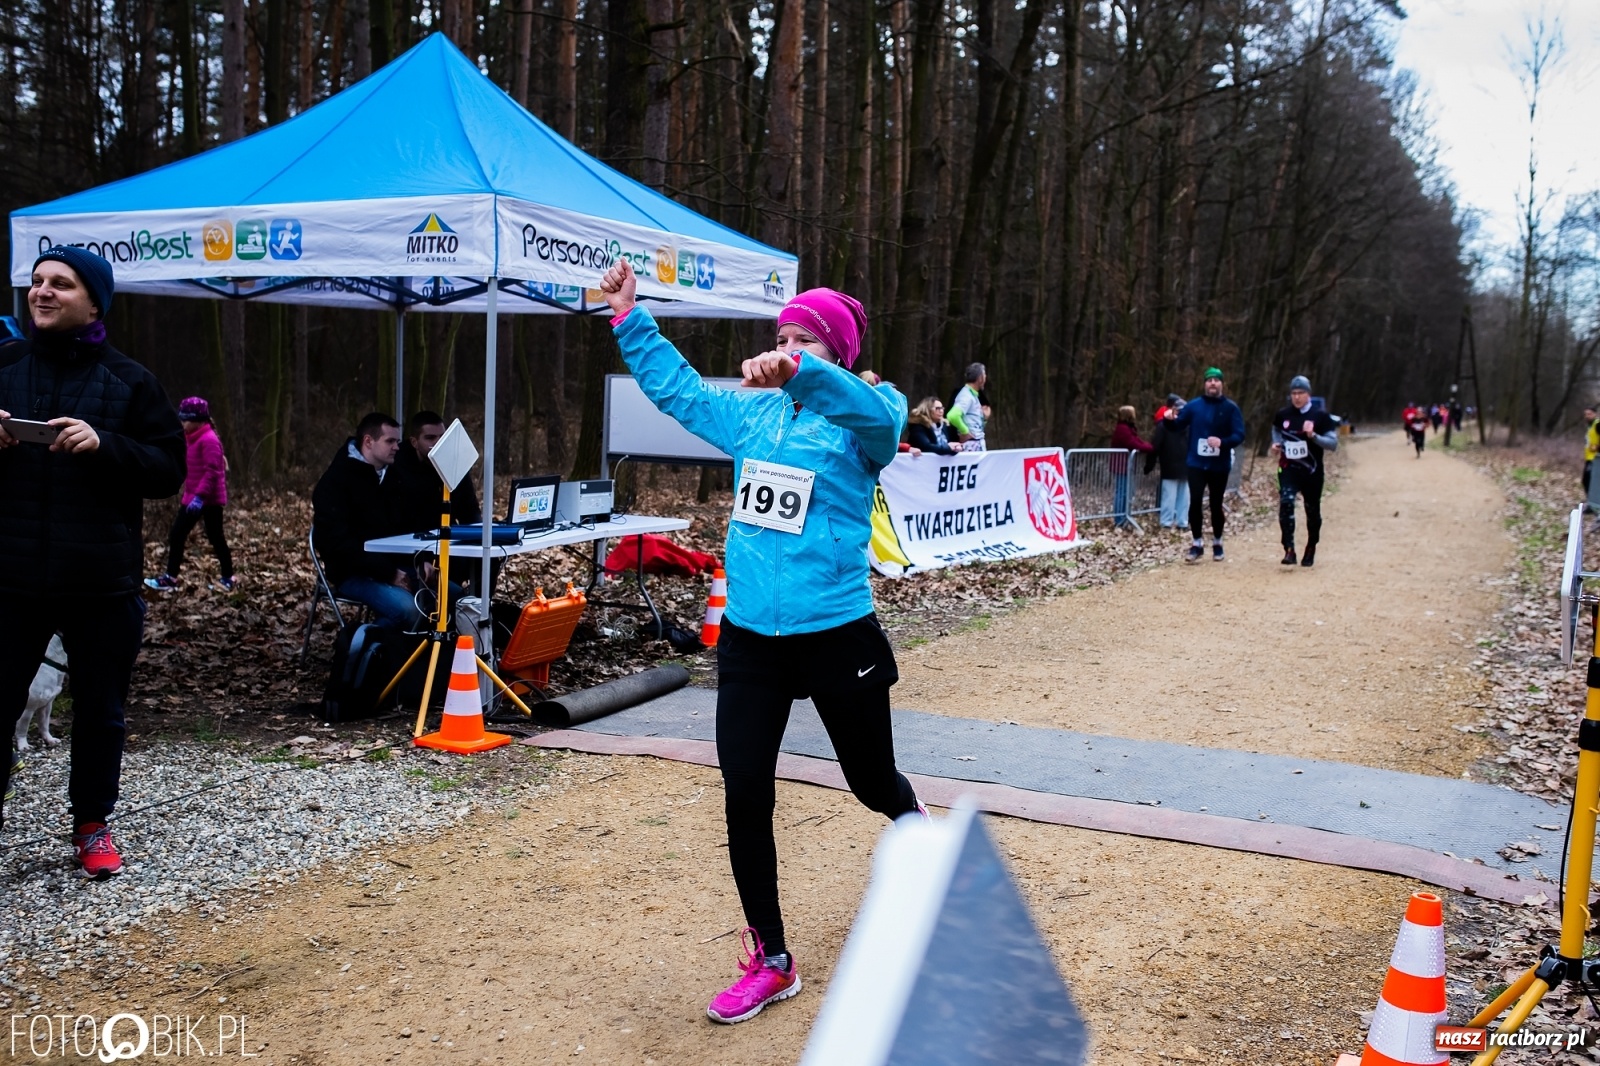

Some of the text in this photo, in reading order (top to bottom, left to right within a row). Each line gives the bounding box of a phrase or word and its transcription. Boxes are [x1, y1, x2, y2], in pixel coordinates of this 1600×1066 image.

[38, 229, 194, 263] PonalBest
[406, 255, 457, 263] for events
[407, 235, 459, 254] MITKO
[938, 463, 979, 493] BIEG
[740, 482, 802, 520] 199
[904, 500, 1014, 541] TWARDZIELA
